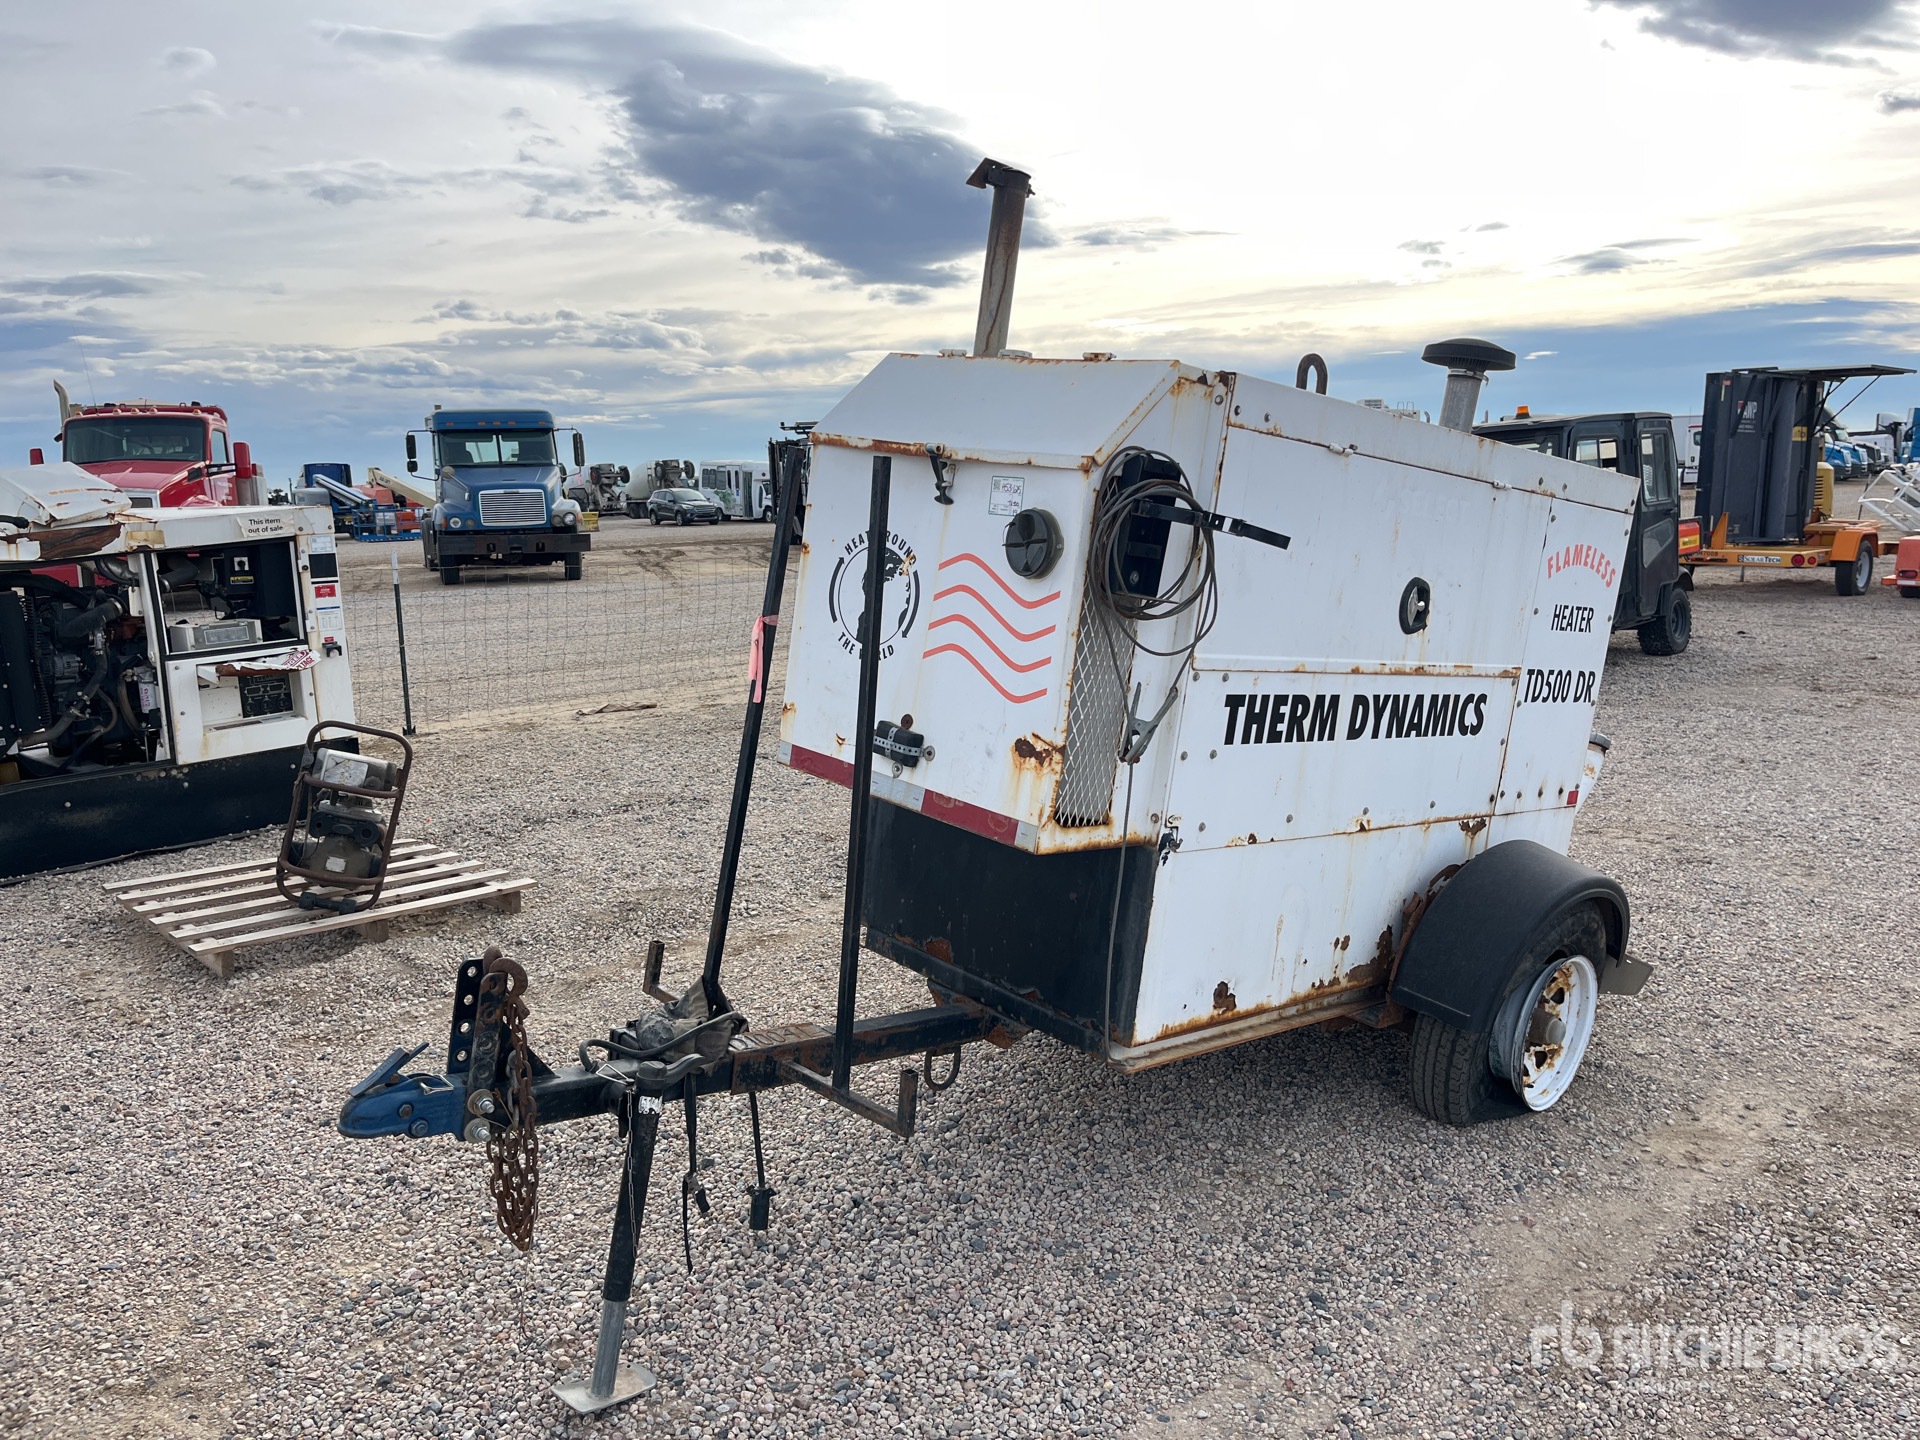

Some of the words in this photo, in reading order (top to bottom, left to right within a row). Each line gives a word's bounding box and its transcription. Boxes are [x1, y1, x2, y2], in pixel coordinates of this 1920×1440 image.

[247, 526, 260, 534] out
[248, 518, 264, 526] This
[1547, 543, 1616, 588] FLAMELESS
[1551, 604, 1594, 633] HEATER
[837, 631, 856, 655] THE
[1524, 669, 1572, 703] TD500
[1573, 670, 1596, 703] DR
[1223, 694, 1341, 746] THERM
[1346, 693, 1488, 741] DYNAMICS
